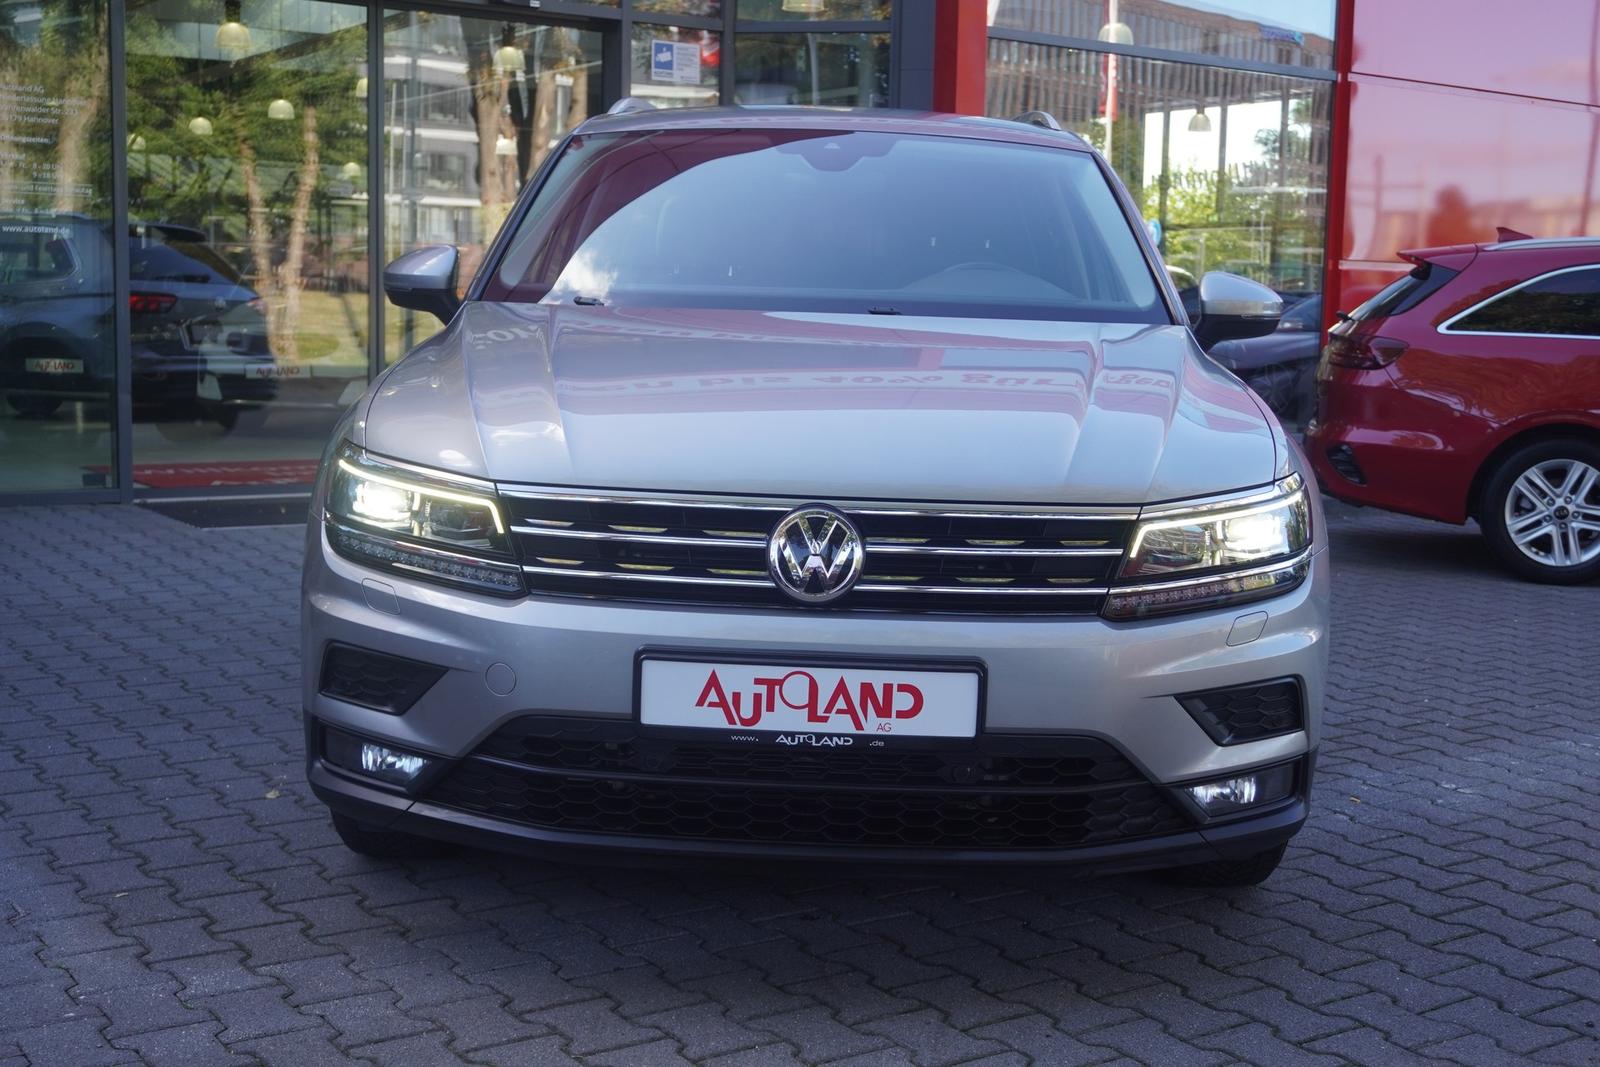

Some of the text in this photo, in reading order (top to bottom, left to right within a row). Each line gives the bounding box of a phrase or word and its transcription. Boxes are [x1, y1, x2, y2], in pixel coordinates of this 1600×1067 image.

[24, 115, 59, 125] Hannover
[2, 225, 70, 234] www.autoland.de
[695, 669, 924, 731] AUTOLAND
[876, 723, 892, 733] AG
[775, 734, 853, 748] AUTOLAND
